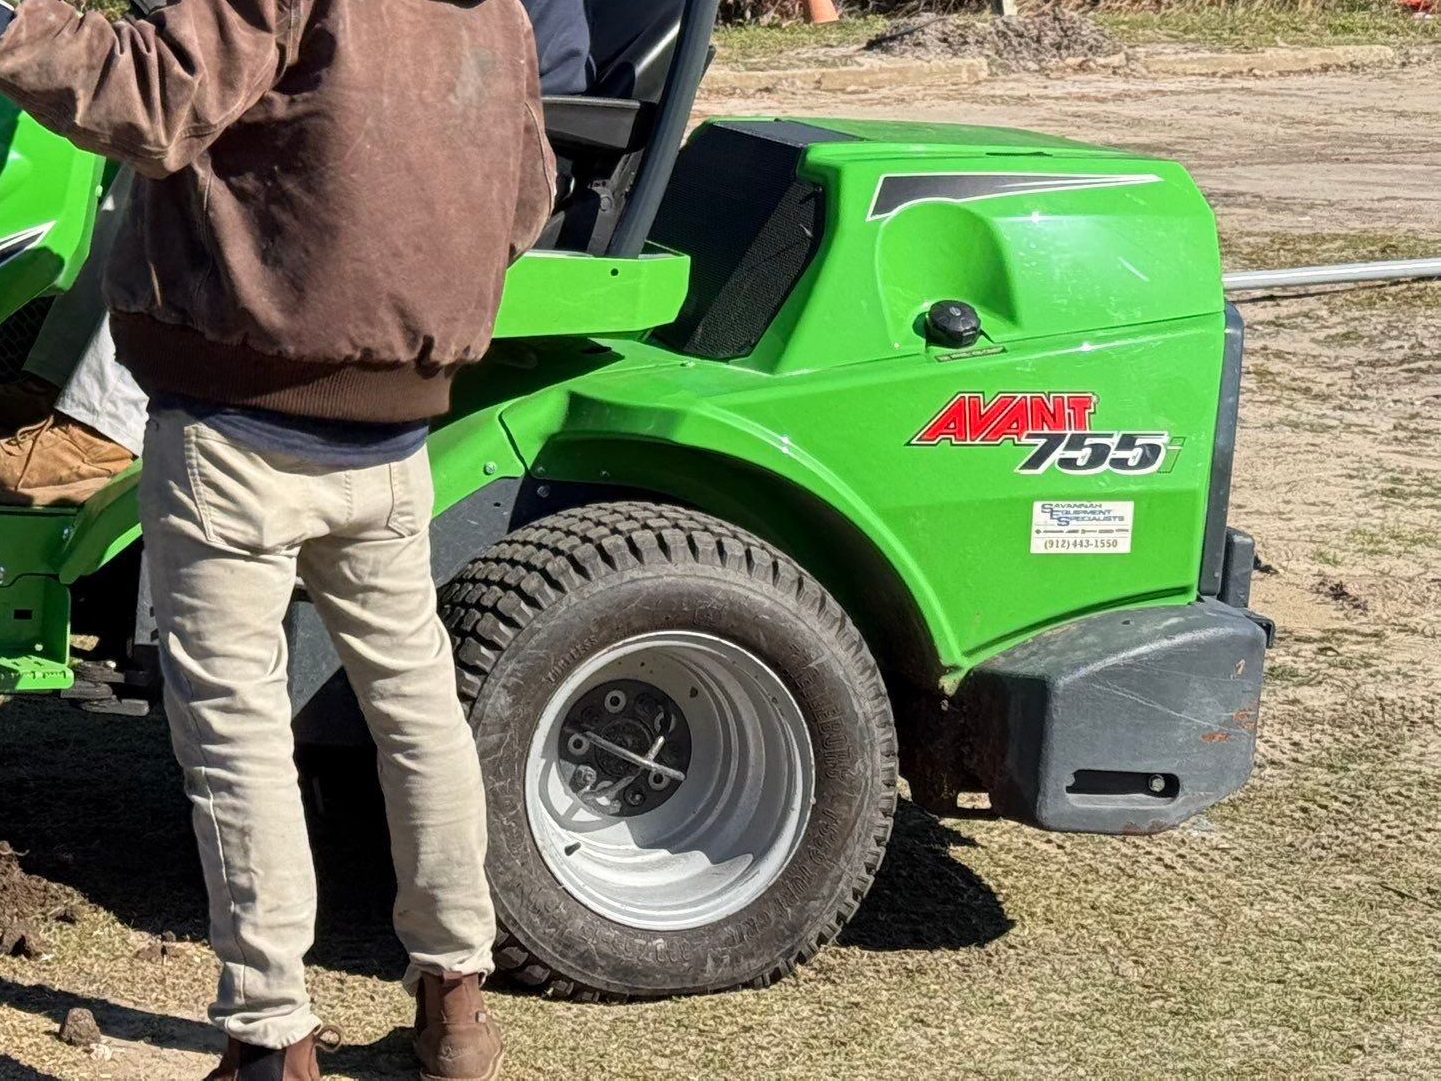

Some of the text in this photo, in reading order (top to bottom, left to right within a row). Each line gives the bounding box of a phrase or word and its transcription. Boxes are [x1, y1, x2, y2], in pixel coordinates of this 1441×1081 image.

[908, 393, 1096, 445] AVANT
[1050, 509, 1113, 520] EQUIPMENT
[1057, 515, 1125, 527] SPECIALISTS
